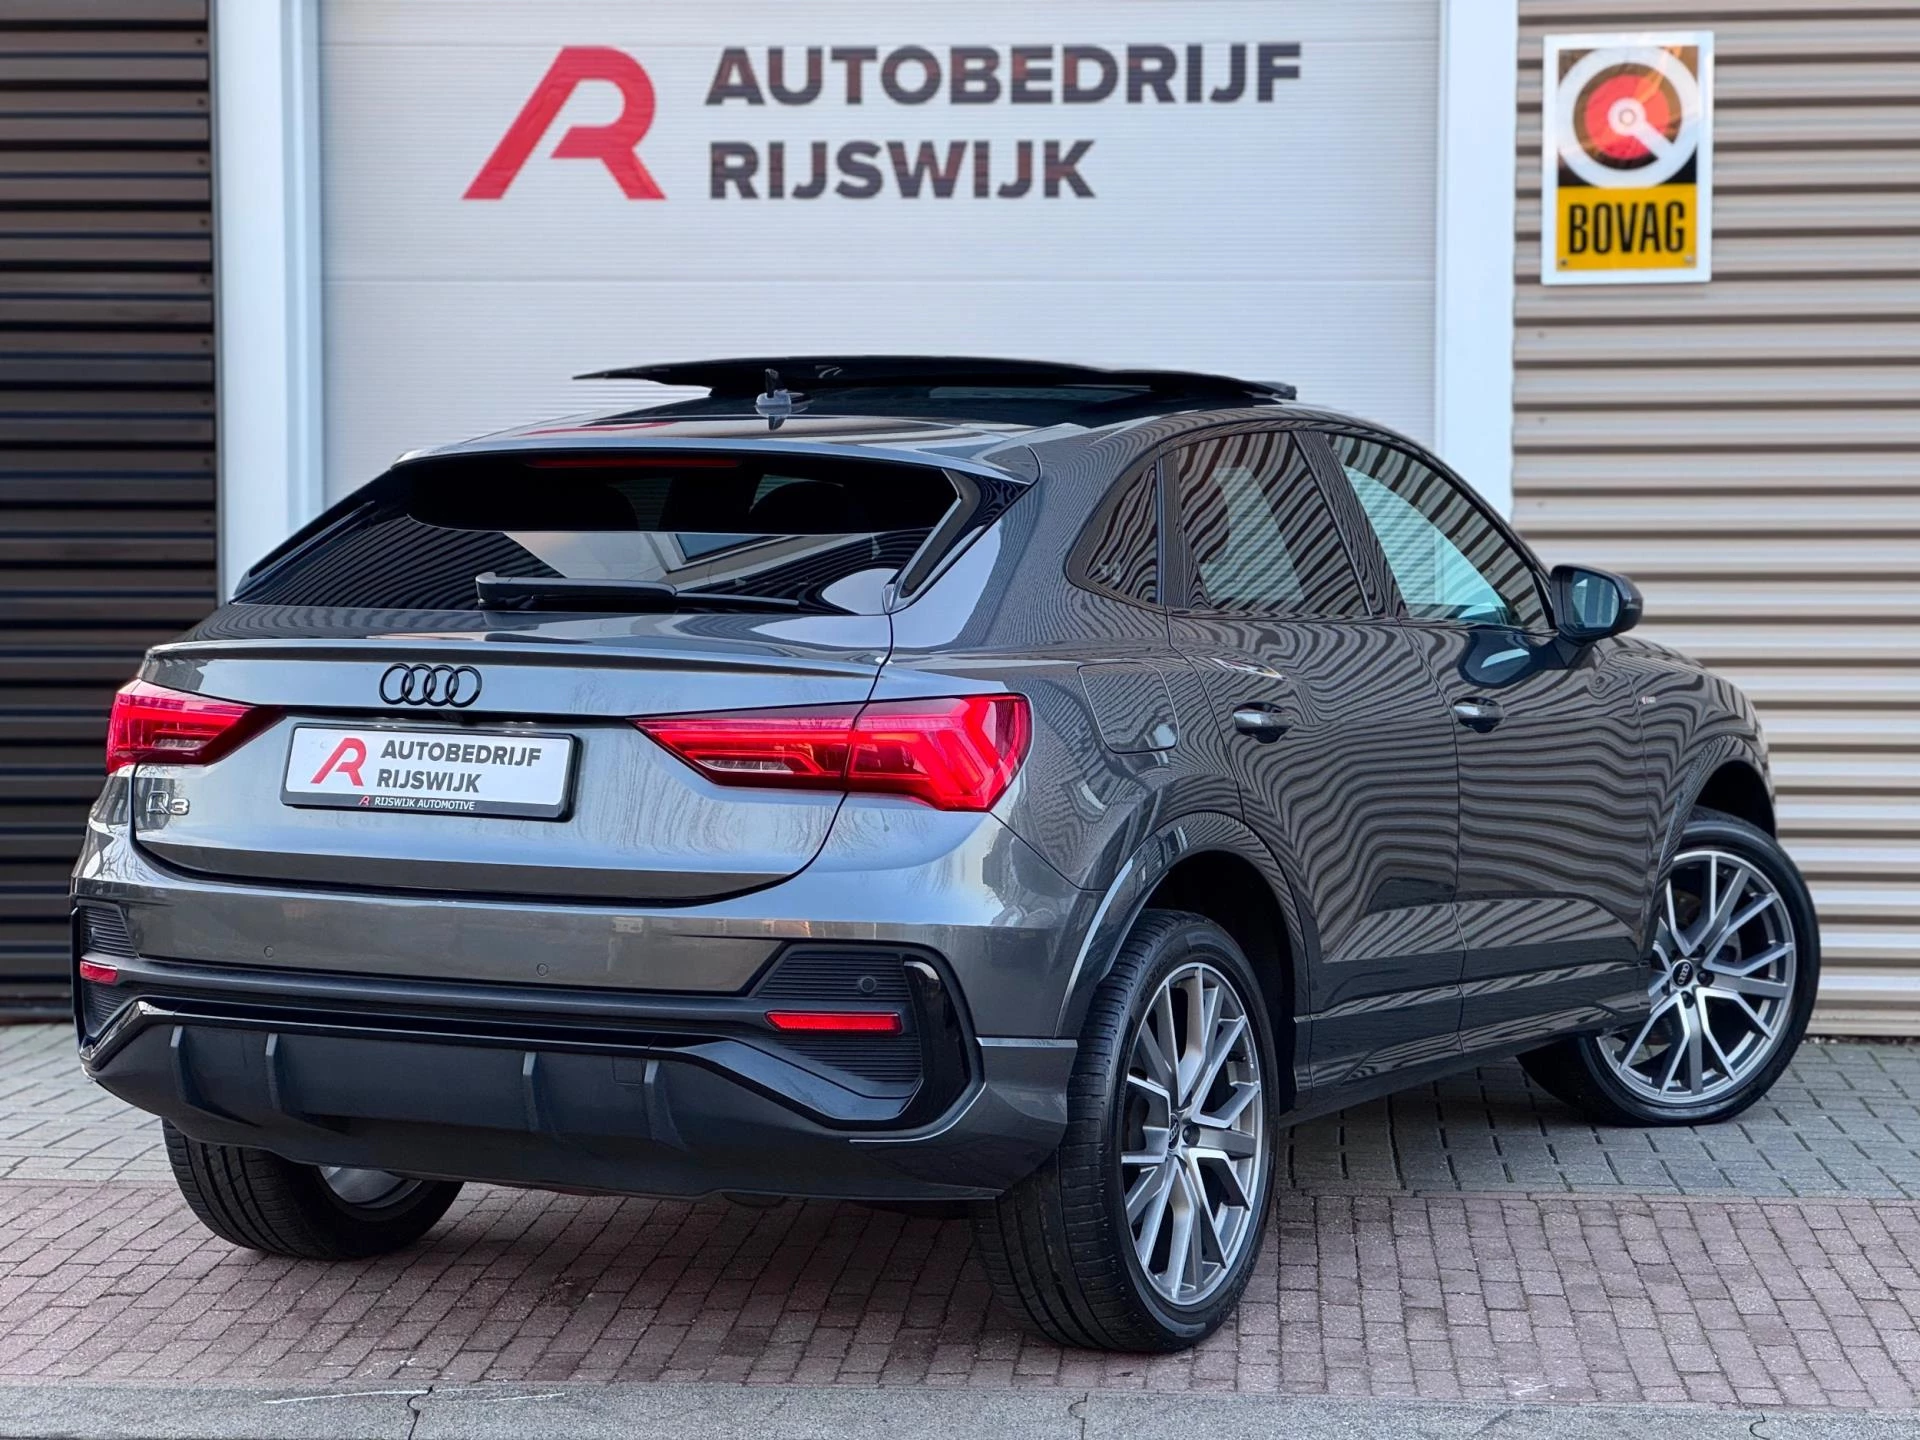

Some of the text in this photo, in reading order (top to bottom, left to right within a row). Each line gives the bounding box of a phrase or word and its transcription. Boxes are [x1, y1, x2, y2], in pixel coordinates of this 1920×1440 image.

[705, 42, 1302, 106] AUTOBEDRIJF
[709, 139, 1097, 199] RIJSWIJK
[1567, 201, 1686, 255] BOVAG
[379, 739, 542, 767] AUTOBEDRIJF
[375, 768, 483, 794] RIJSWIJK
[373, 795, 416, 808] RIJSWIJK
[416, 798, 476, 811] AUTOMOTIVE
